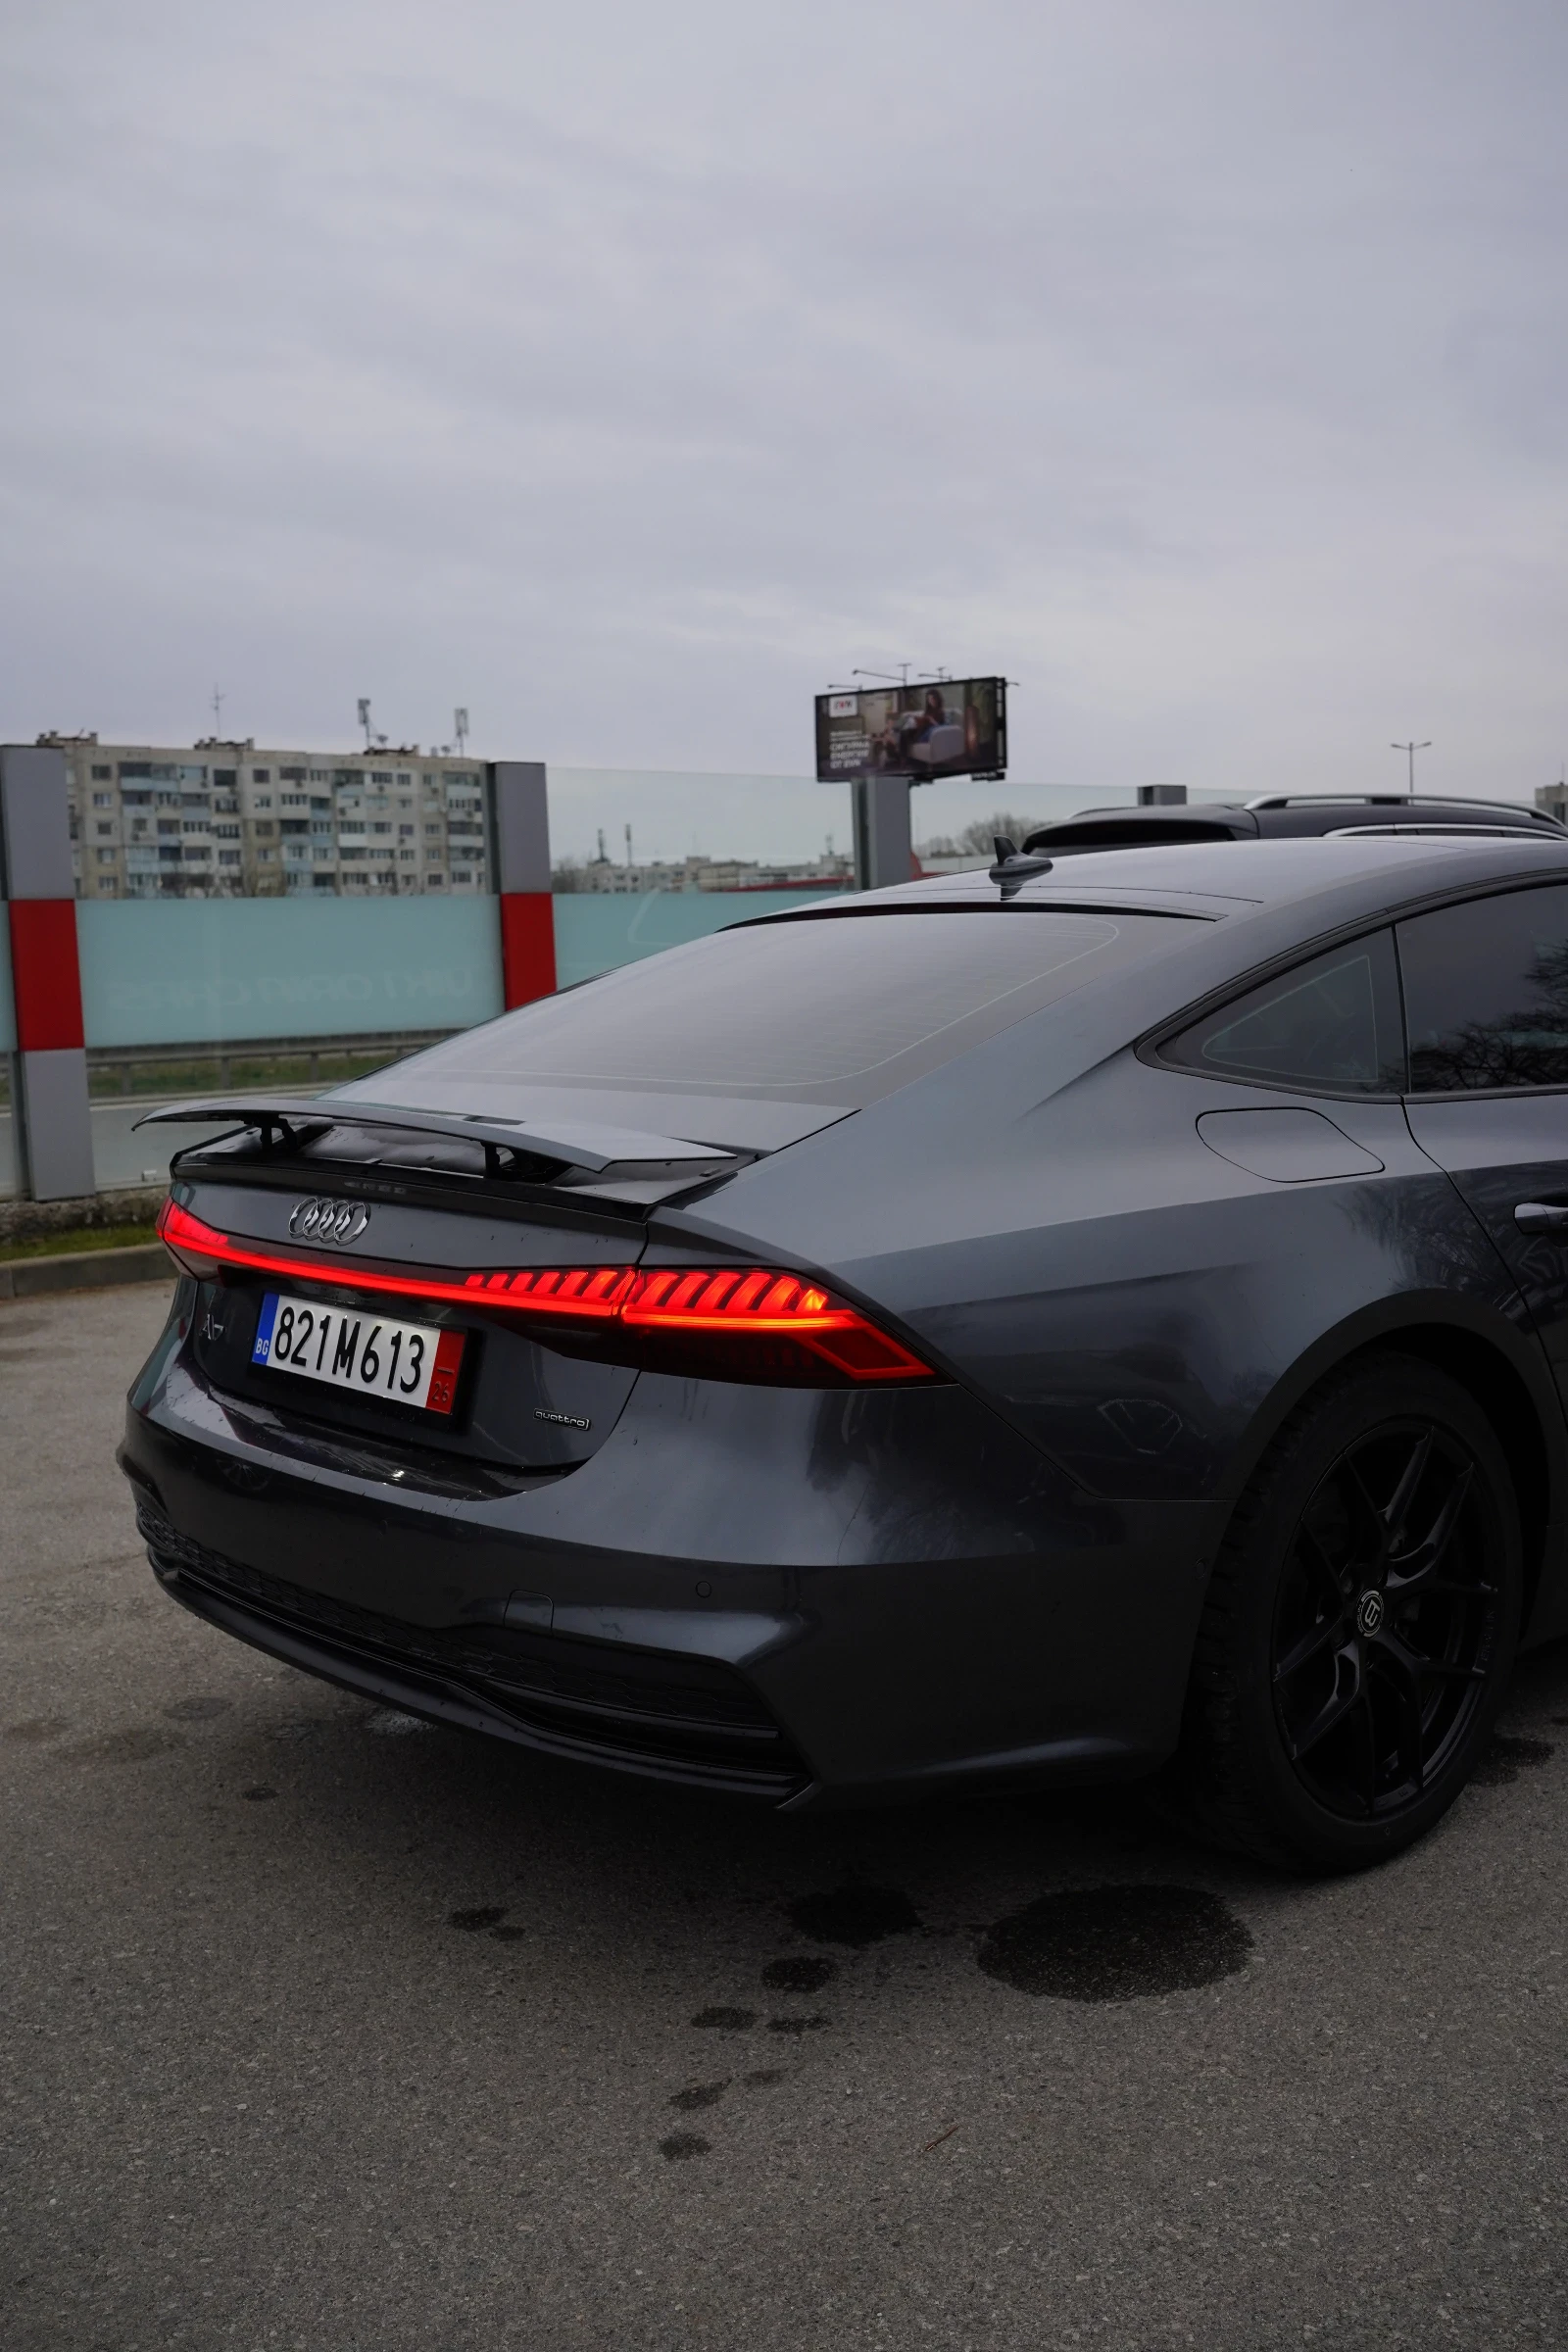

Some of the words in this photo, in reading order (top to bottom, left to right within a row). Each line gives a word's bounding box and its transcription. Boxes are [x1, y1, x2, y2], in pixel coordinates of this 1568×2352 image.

[255, 1338, 270, 1356] BG
[274, 1306, 424, 1394] 821M613
[432, 1380, 450, 1403] 26
[535, 1410, 586, 1427] quattro
